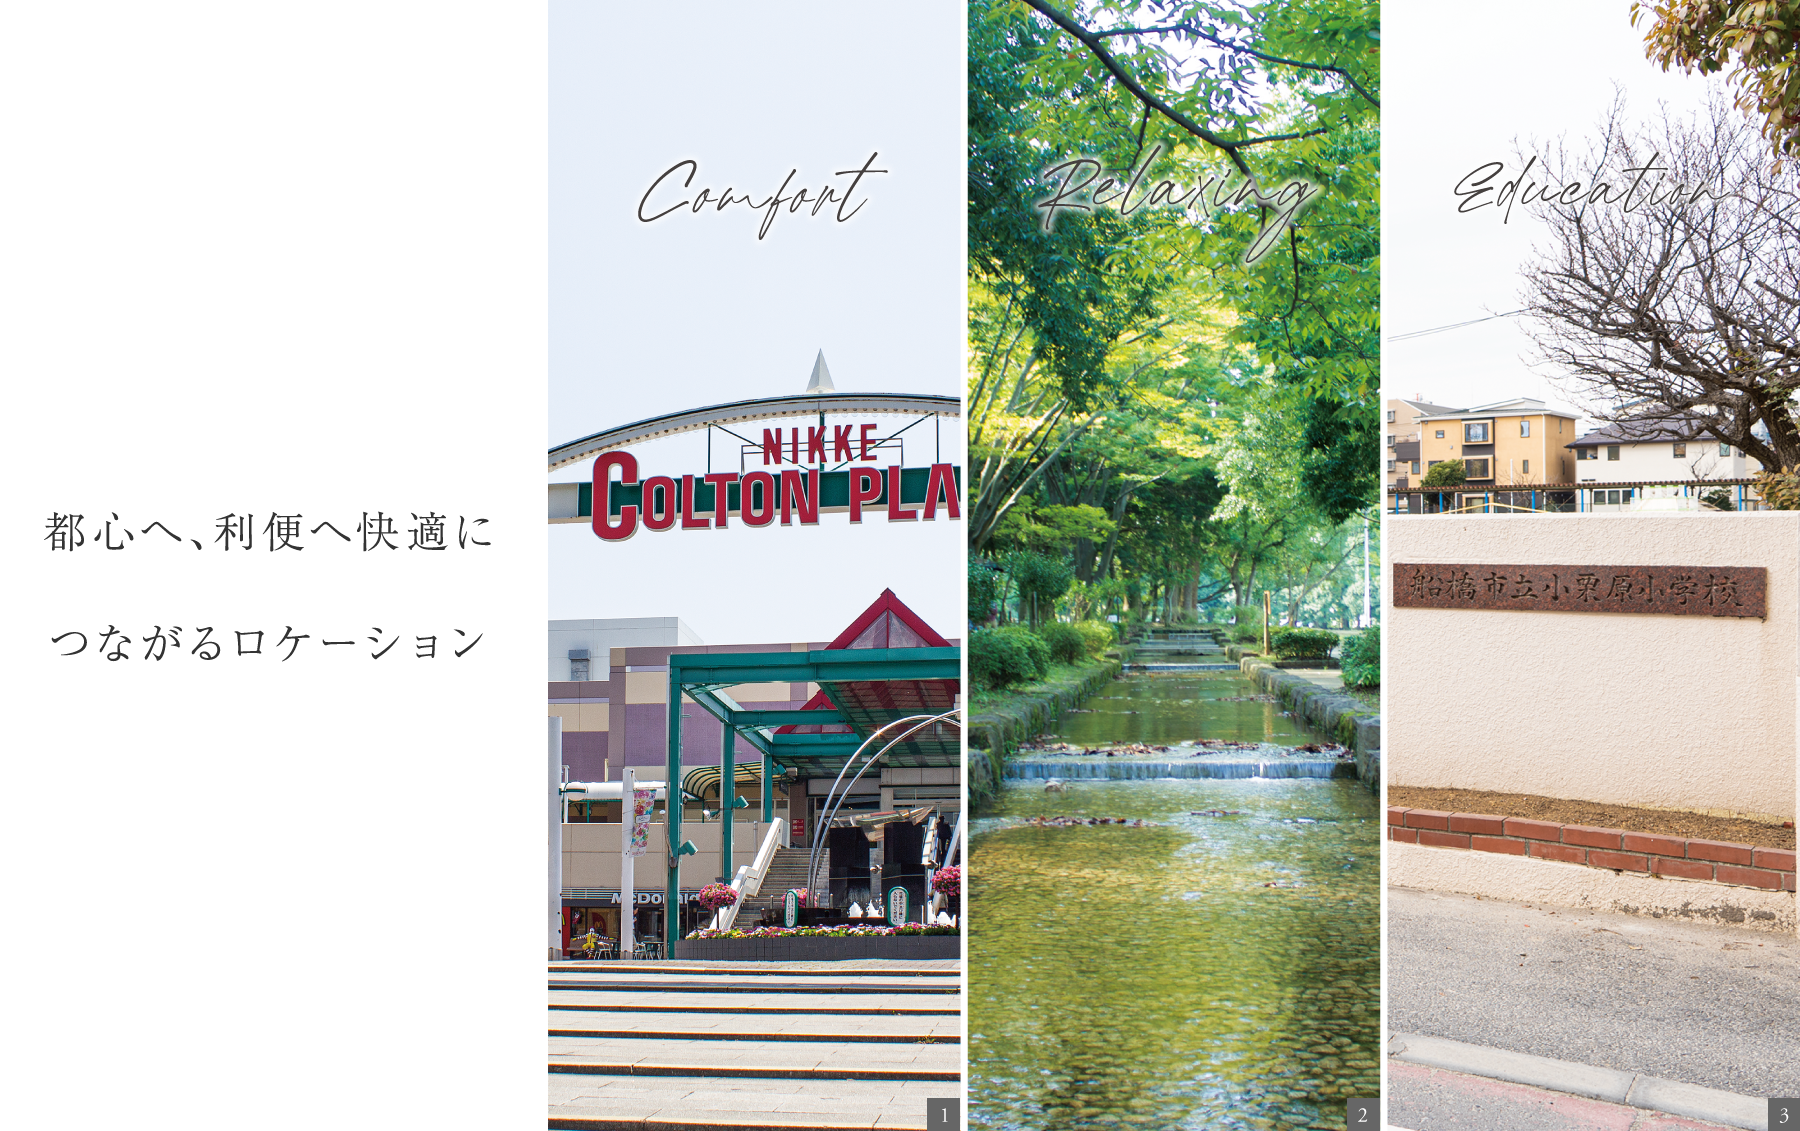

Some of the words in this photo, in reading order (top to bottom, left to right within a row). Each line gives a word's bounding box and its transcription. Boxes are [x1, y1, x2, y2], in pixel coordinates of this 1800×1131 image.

[763, 423, 878, 466] NIKKE
[591, 450, 820, 542] COLTON
[1409, 568, 1744, 607] 船橋市立小栗原小学校
